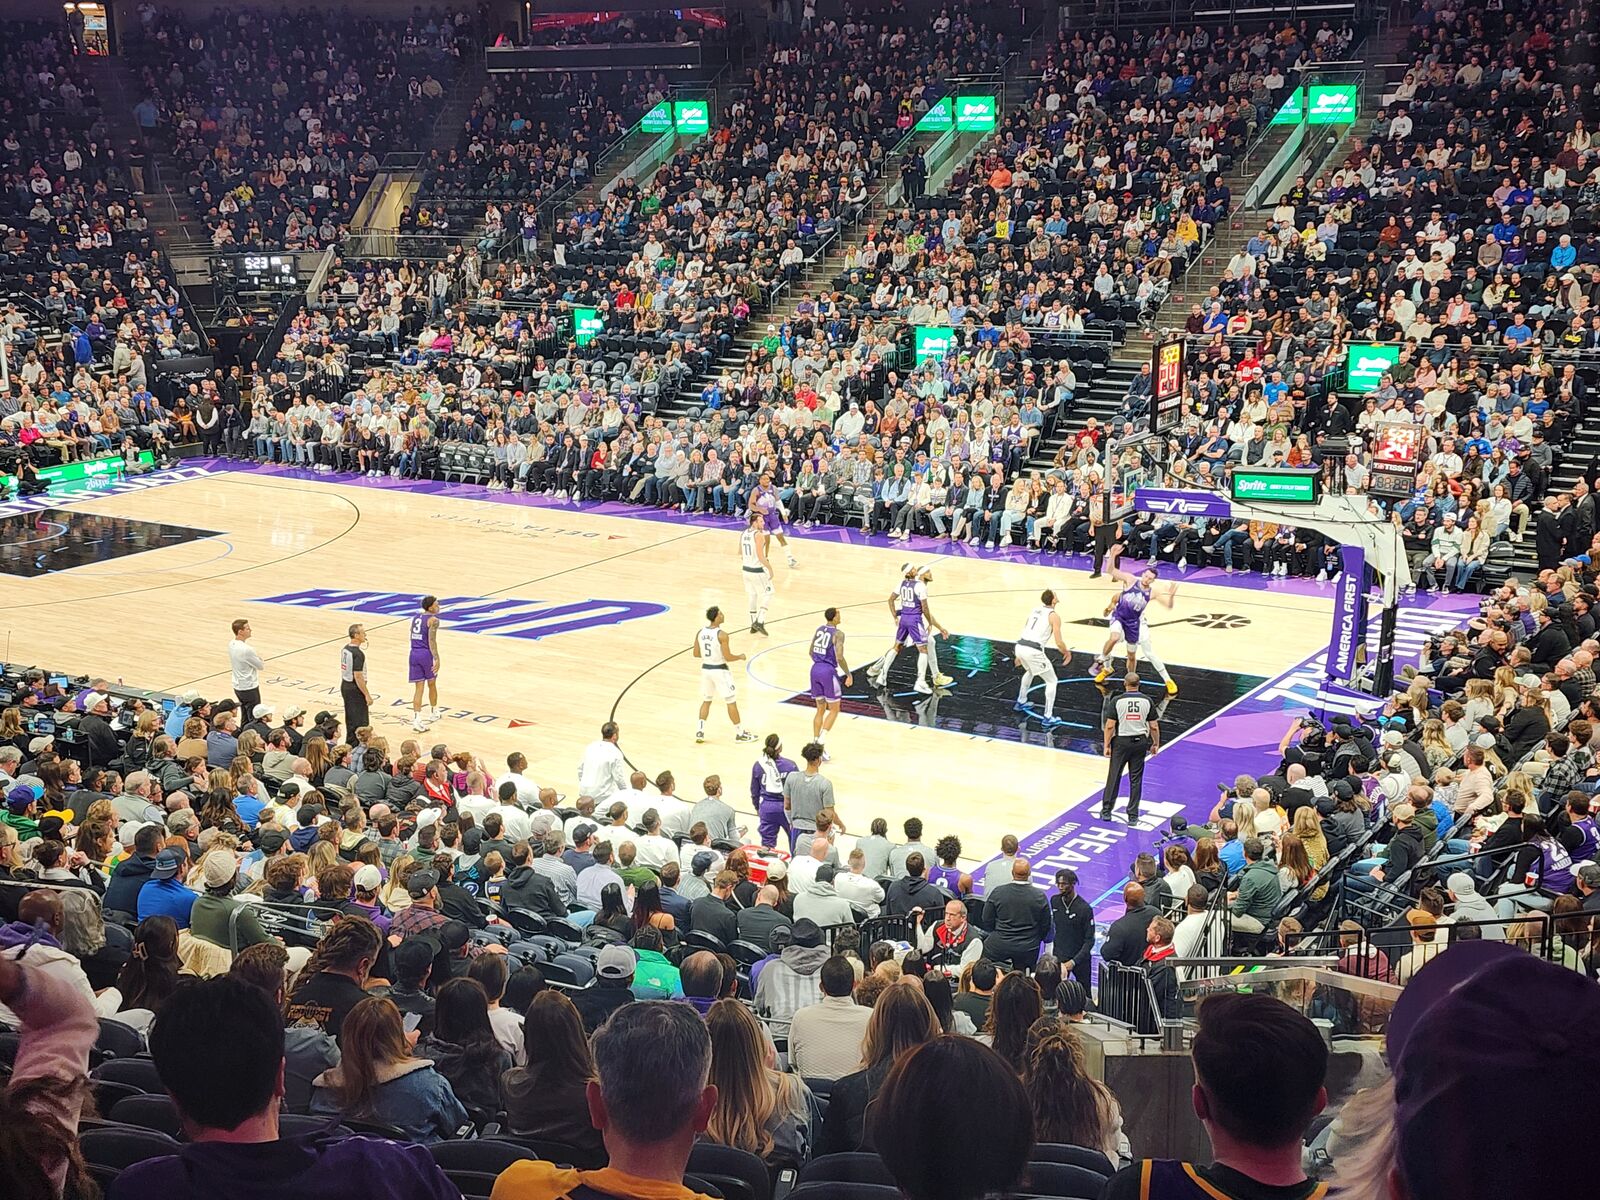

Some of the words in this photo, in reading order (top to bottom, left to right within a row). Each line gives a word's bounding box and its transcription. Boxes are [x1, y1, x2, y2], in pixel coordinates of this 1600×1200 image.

[1384, 441, 1408, 459] 24
[1385, 463, 1415, 473] TISSOT
[1237, 479, 1267, 492] Sprite
[900, 585, 914, 602] 00
[1343, 573, 1357, 613] FIRST
[412, 617, 422, 634] 3
[813, 630, 831, 649] 20
[1335, 613, 1354, 673] AMERICA
[704, 642, 712, 657] 5
[264, 674, 382, 704] CNTER
[1127, 700, 1140, 713] 25
[1016, 821, 1082, 859] UNIVERSITY
[1029, 825, 1128, 891] HEALT
